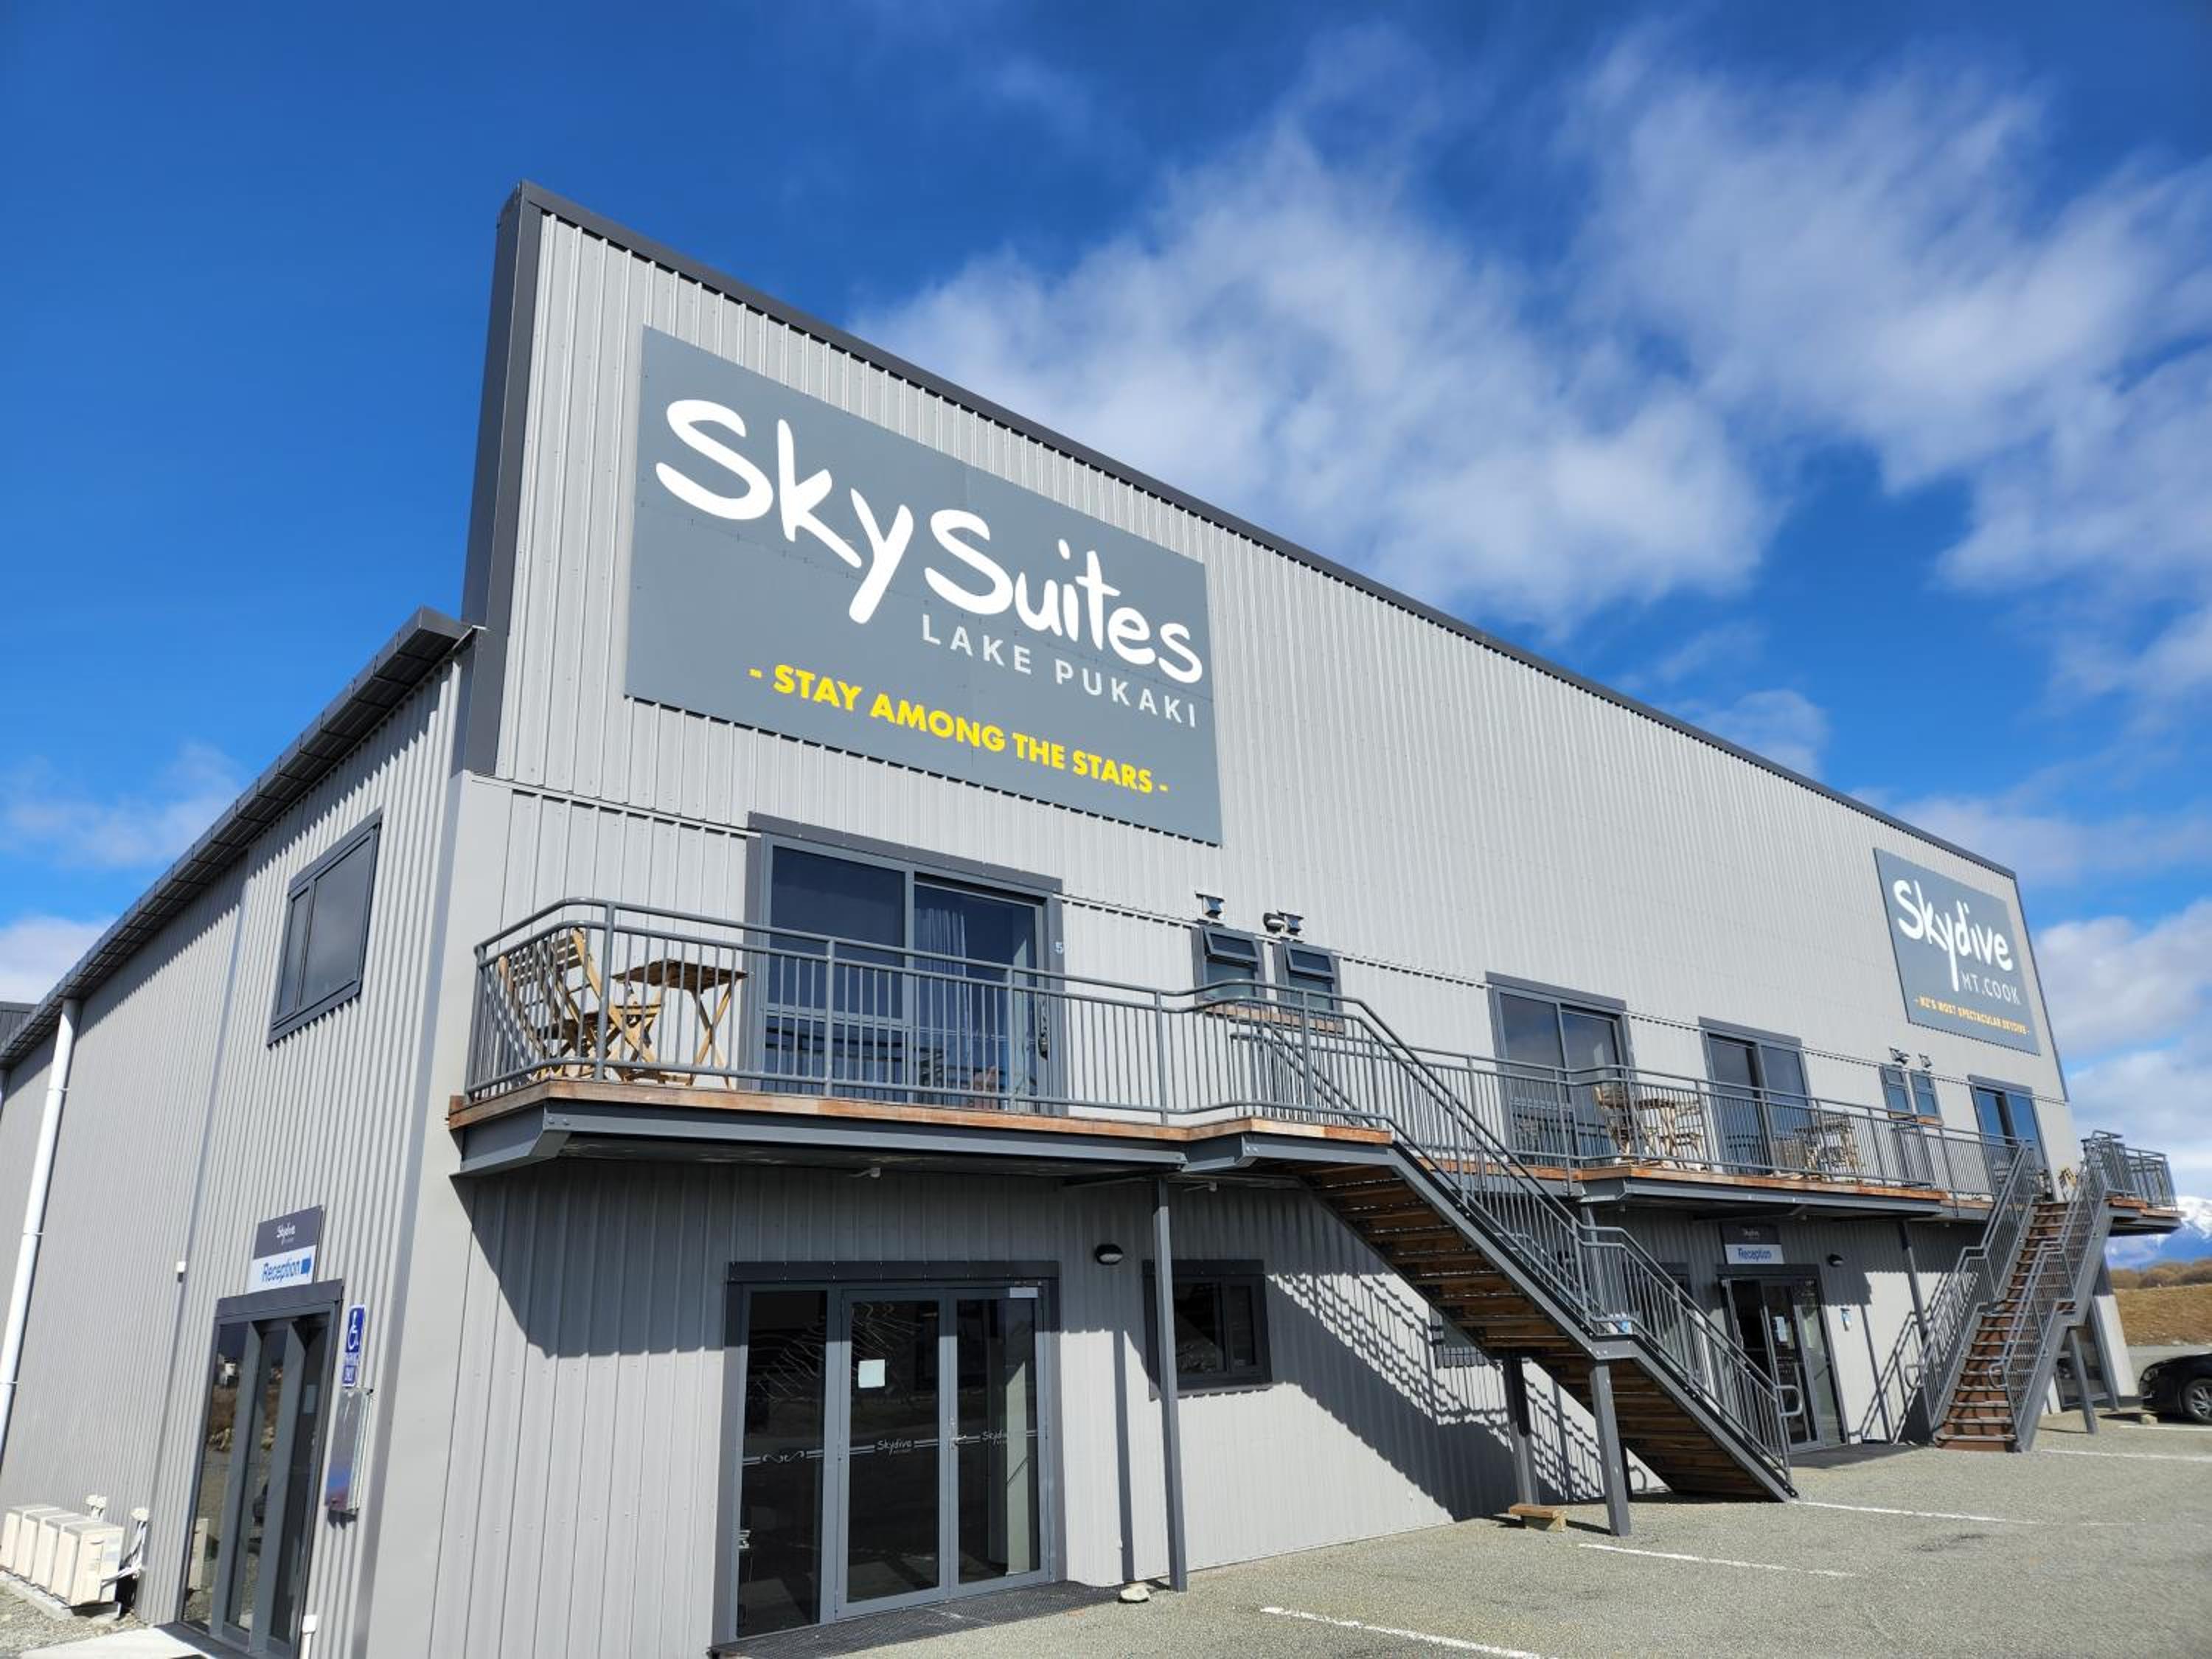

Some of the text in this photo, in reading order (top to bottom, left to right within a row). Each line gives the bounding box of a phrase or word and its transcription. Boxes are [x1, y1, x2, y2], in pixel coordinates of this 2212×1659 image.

[922, 613, 1196, 728] LAKE PUKAKI
[774, 665, 861, 710] STAY
[871, 692, 1006, 751] AMONG
[1013, 732, 1065, 769] THE
[1073, 750, 1152, 793] STARS
[1893, 880, 2013, 992] Skydive
[262, 1259, 300, 1282] Reception
[877, 1439, 912, 1455] Skydive
